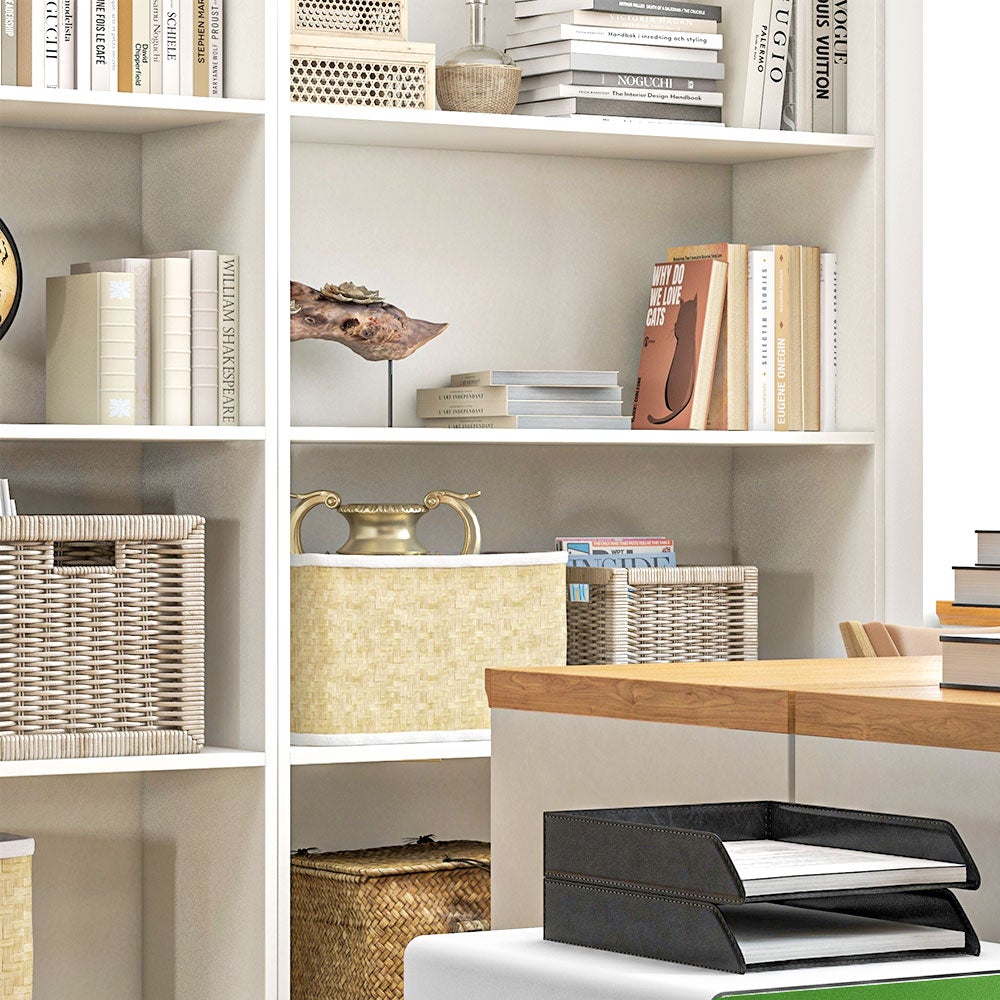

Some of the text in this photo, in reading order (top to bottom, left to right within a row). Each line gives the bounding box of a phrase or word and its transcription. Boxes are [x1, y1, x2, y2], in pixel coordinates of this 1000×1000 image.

[5, 0, 14, 37] EADERSHIP
[96, 14, 105, 32] FOIS
[167, 12, 176, 61] SCHIELE
[211, 6, 219, 40] PROUST
[834, 0, 847, 65] VOGUE
[96, 33, 105, 43] LE
[96, 44, 107, 65] CAFÉ
[152, 24, 160, 62] Noguchi
[641, 34, 672, 42] inredning
[757, 25, 768, 72] PALERMO
[770, 0, 790, 83] UGIO
[816, 0, 829, 99] UIS VUITTON
[617, 75, 673, 89] NOGUCHI
[652, 263, 685, 286] WHY DO
[650, 286, 682, 307] WE LOVE
[646, 307, 666, 327] CATS
[223, 259, 235, 423] WILLIAM SHAKESPEARE
[777, 338, 785, 378] ONEGIN
[777, 382, 785, 424] EUGENE
